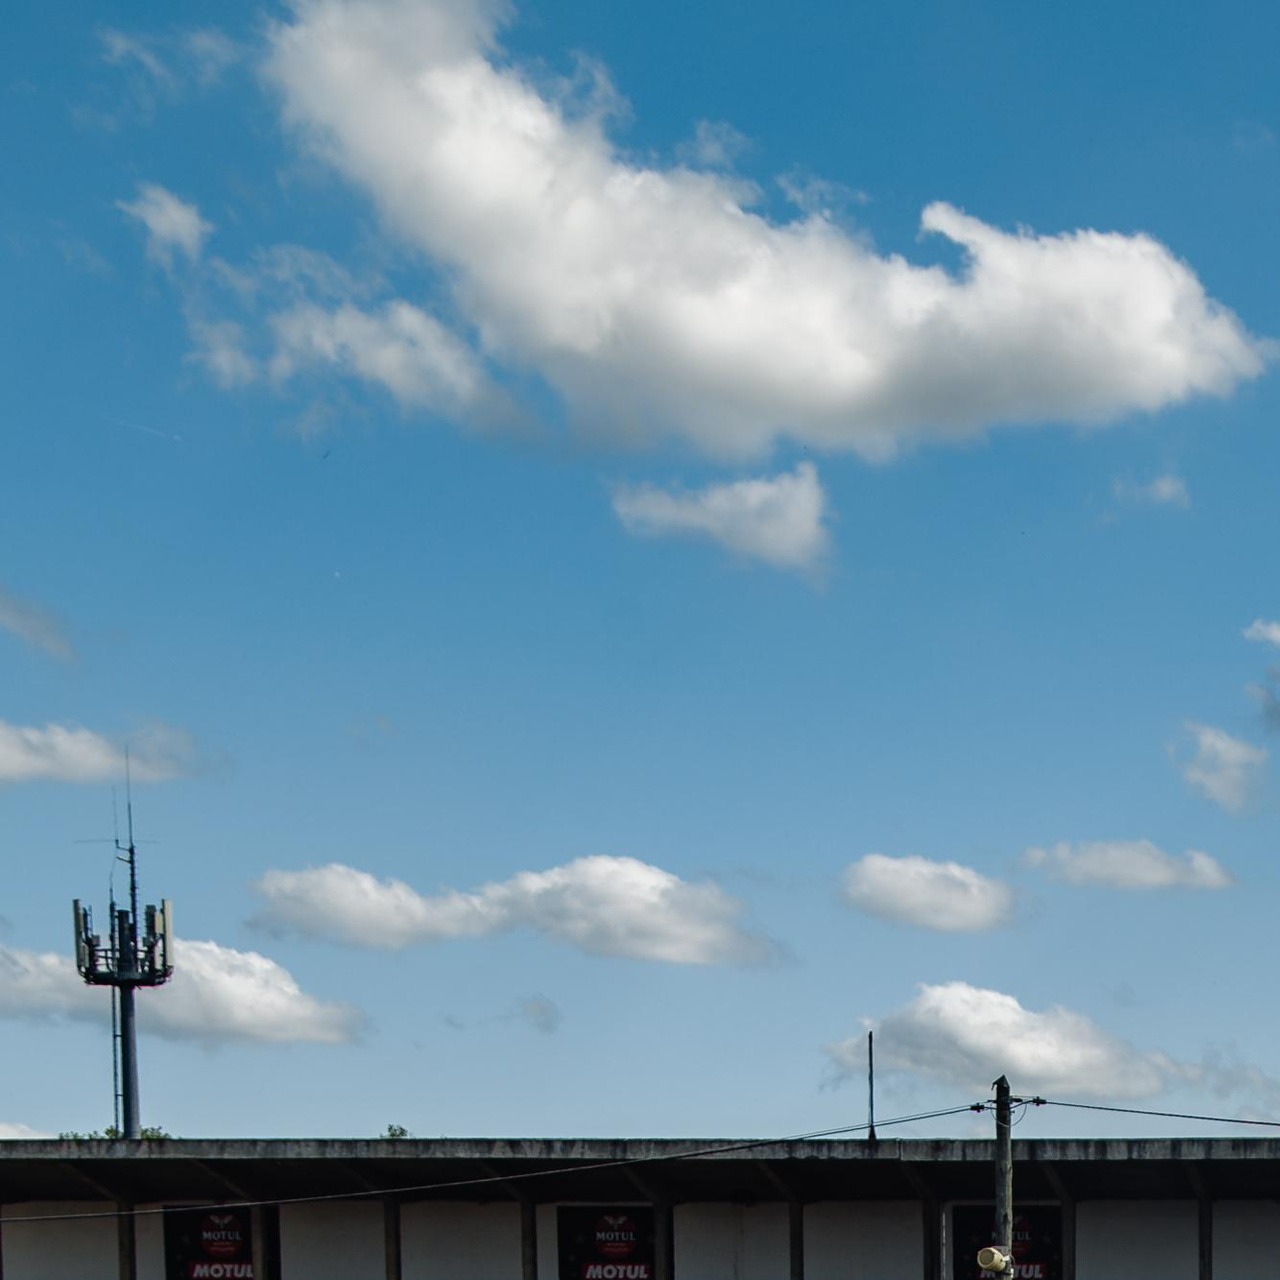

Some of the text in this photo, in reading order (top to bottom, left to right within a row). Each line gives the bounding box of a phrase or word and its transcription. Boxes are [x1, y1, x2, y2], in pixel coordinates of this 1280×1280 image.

[201, 1230, 242, 1240] MOTUL
[596, 1231, 635, 1241] MOTUL
[991, 1231, 1032, 1240] MTUL
[193, 1264, 253, 1278] MOTUL
[586, 1264, 648, 1279] MOTUL
[980, 1264, 1043, 1278] MTUL
